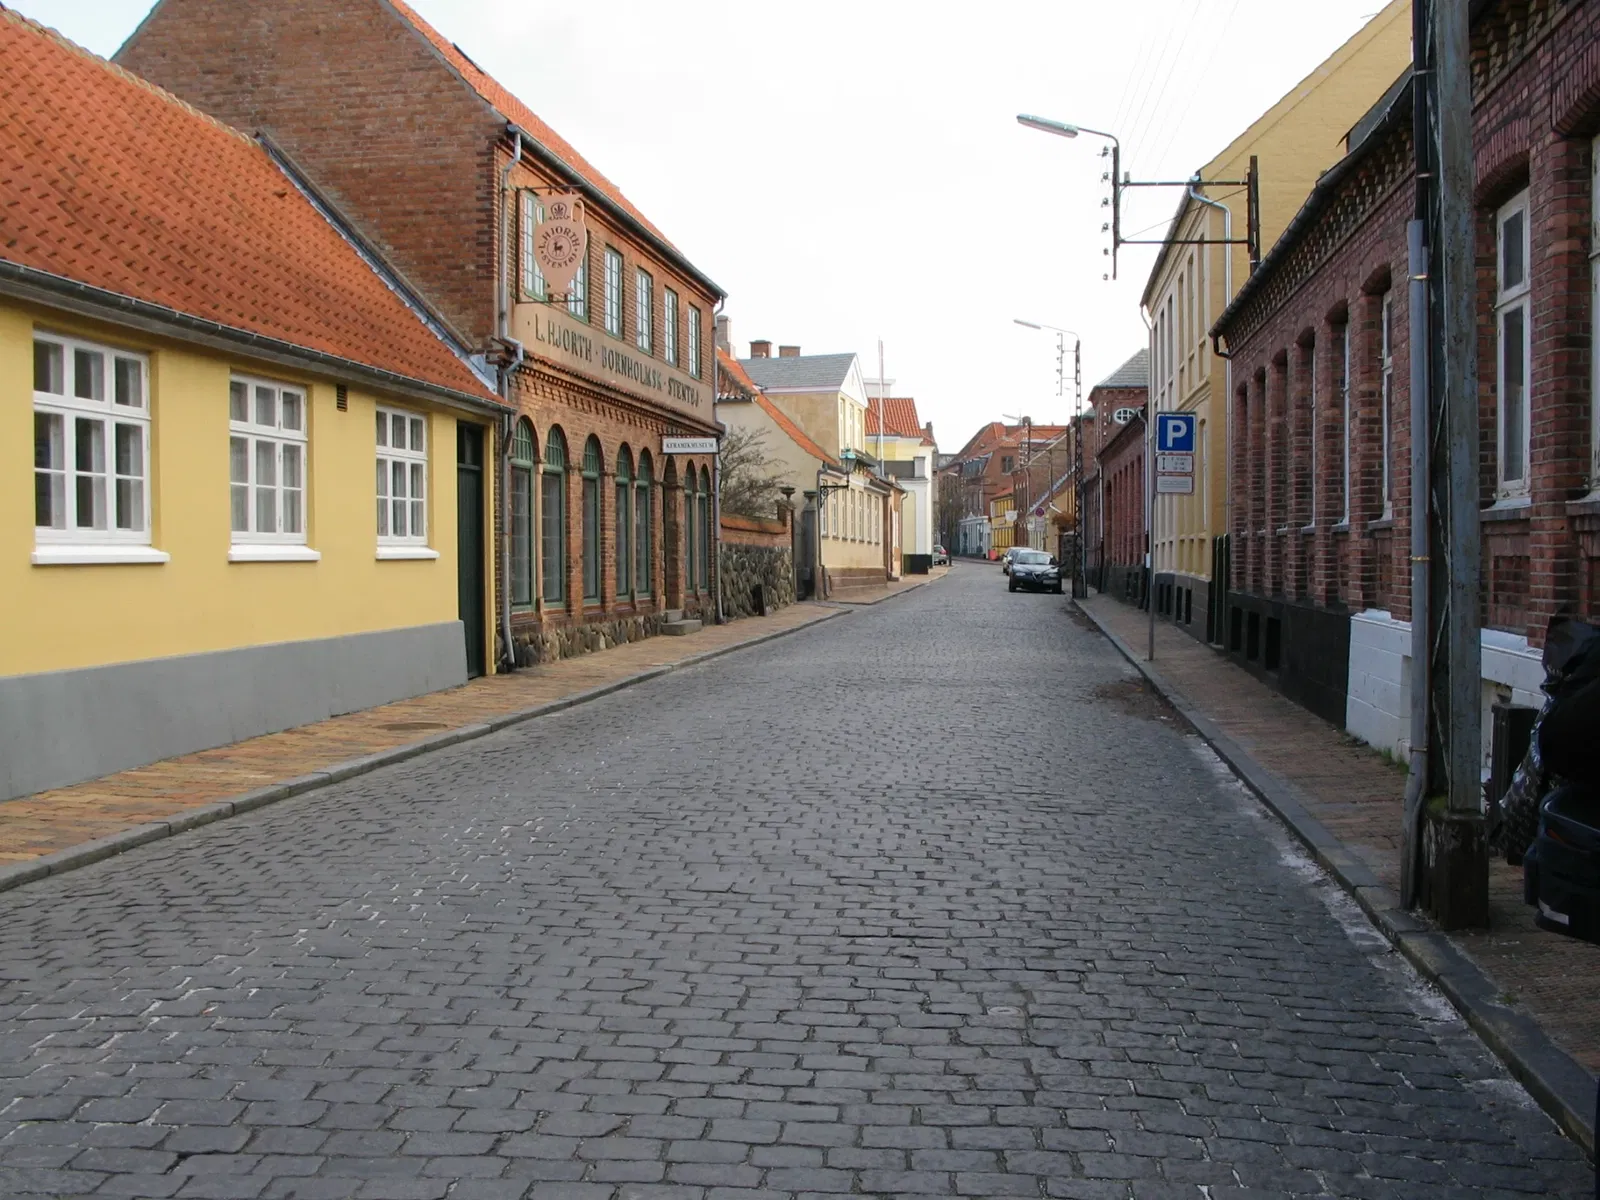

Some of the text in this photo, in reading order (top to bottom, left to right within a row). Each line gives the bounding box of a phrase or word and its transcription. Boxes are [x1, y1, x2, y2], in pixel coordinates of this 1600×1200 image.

[548, 320, 592, 362] HJORTH
[601, 345, 662, 391] BORNHOLMSK
[1167, 420, 1187, 447] P
